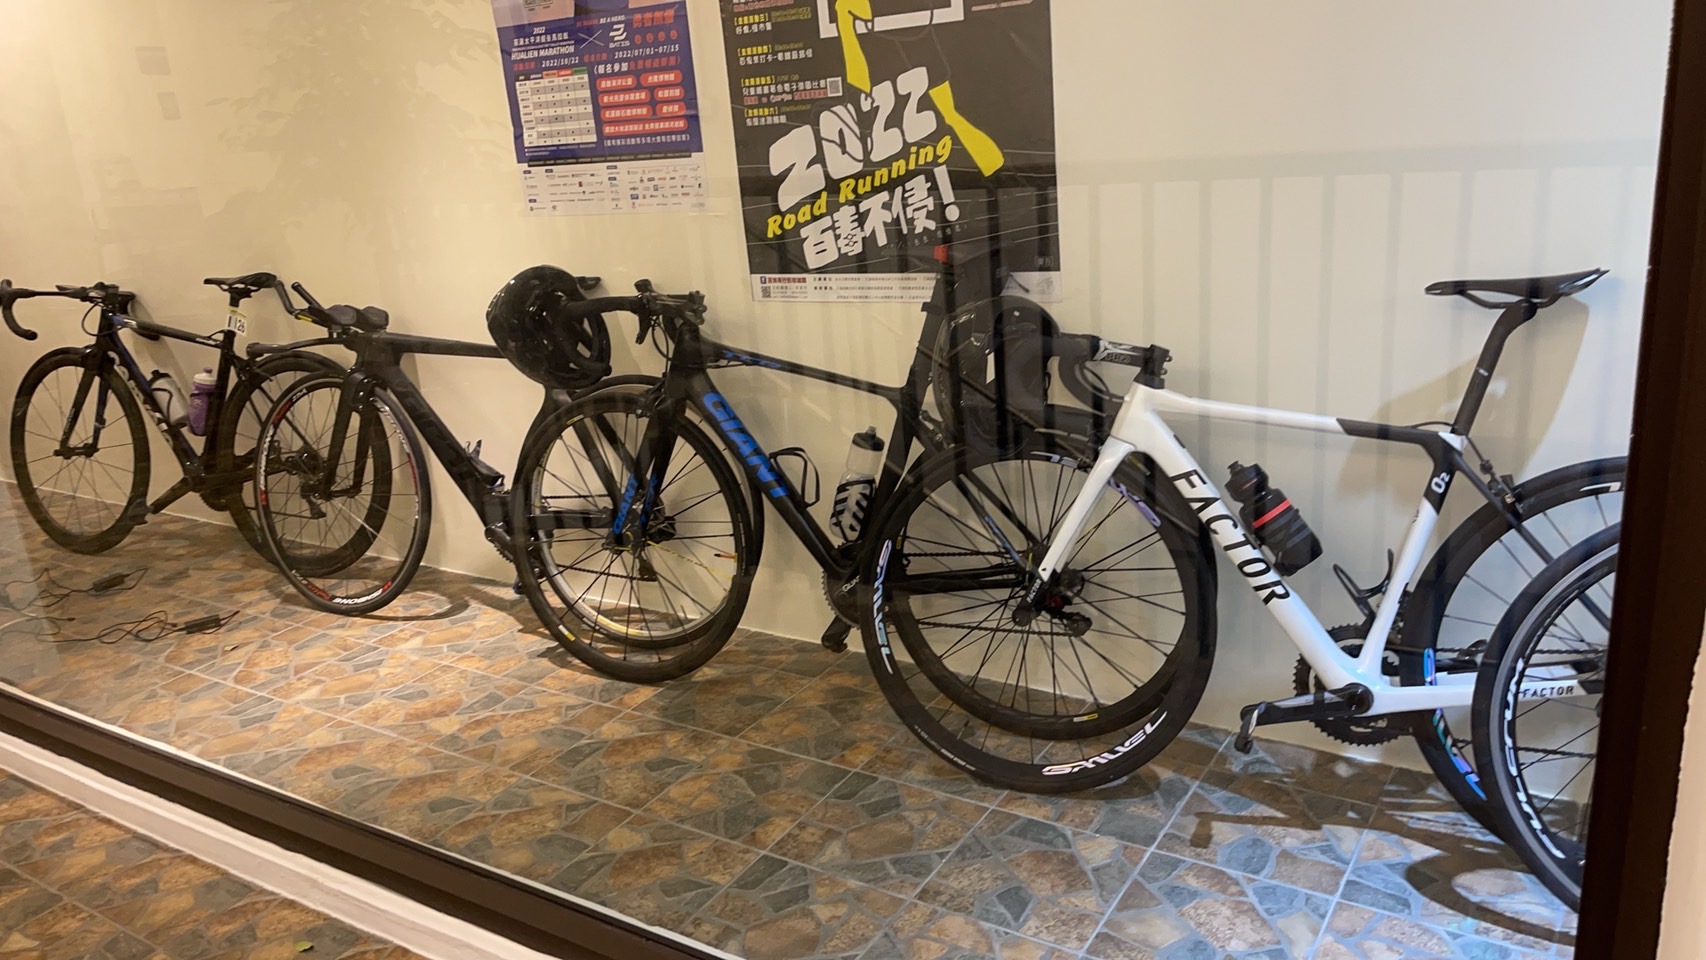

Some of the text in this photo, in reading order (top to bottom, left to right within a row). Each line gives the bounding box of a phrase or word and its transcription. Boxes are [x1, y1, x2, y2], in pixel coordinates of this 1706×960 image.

[511, 48, 538, 60] HUALIEN
[539, 44, 575, 57] MARATHON
[769, 66, 937, 213] 2022
[766, 191, 828, 239] Road
[838, 135, 953, 204] Running
[703, 392, 790, 498] GIANT
[612, 472, 639, 535] GIANT
[1170, 469, 1290, 606] FACTOR
[1026, 578, 1042, 604] FACTOR
[1522, 686, 1576, 699] FACTOR
